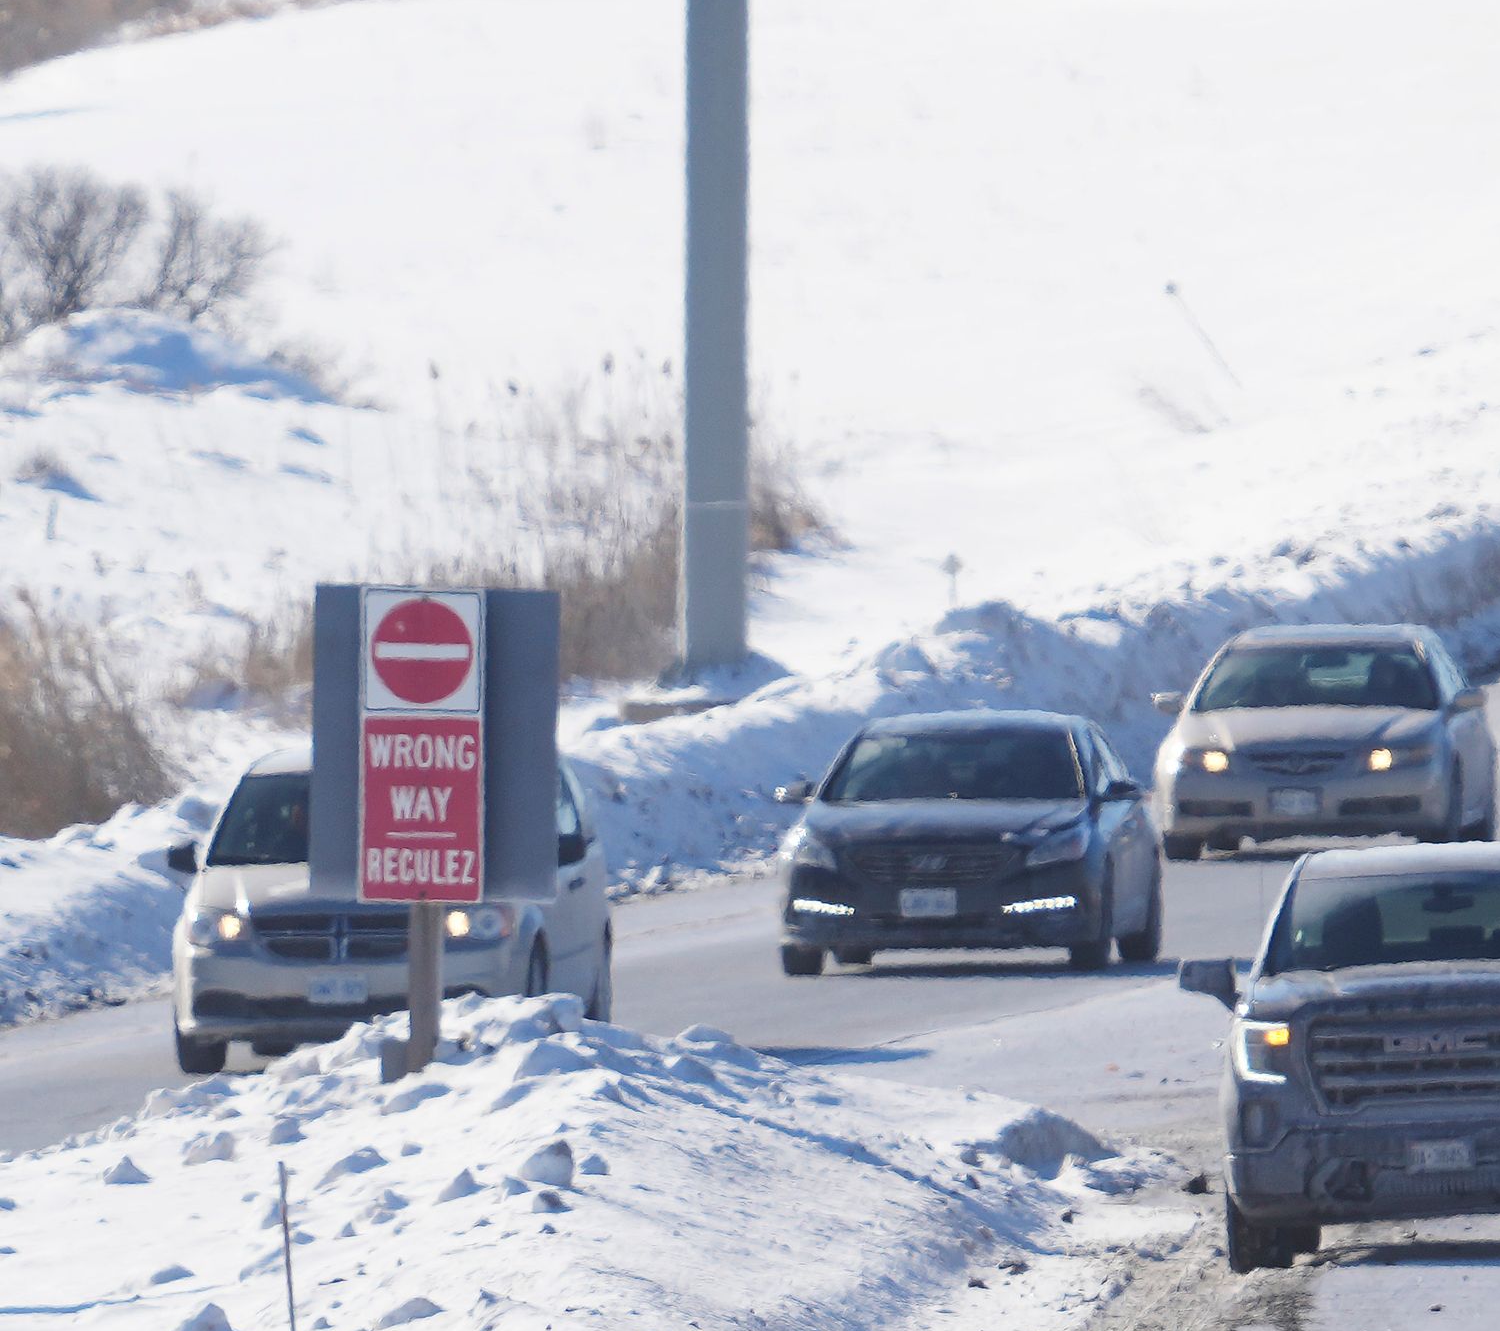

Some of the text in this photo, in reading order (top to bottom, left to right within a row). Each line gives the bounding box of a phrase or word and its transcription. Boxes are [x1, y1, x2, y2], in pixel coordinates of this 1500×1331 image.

[367, 733, 476, 771] WRONG
[390, 785, 452, 822] WAY
[366, 847, 476, 885] RECULEZ
